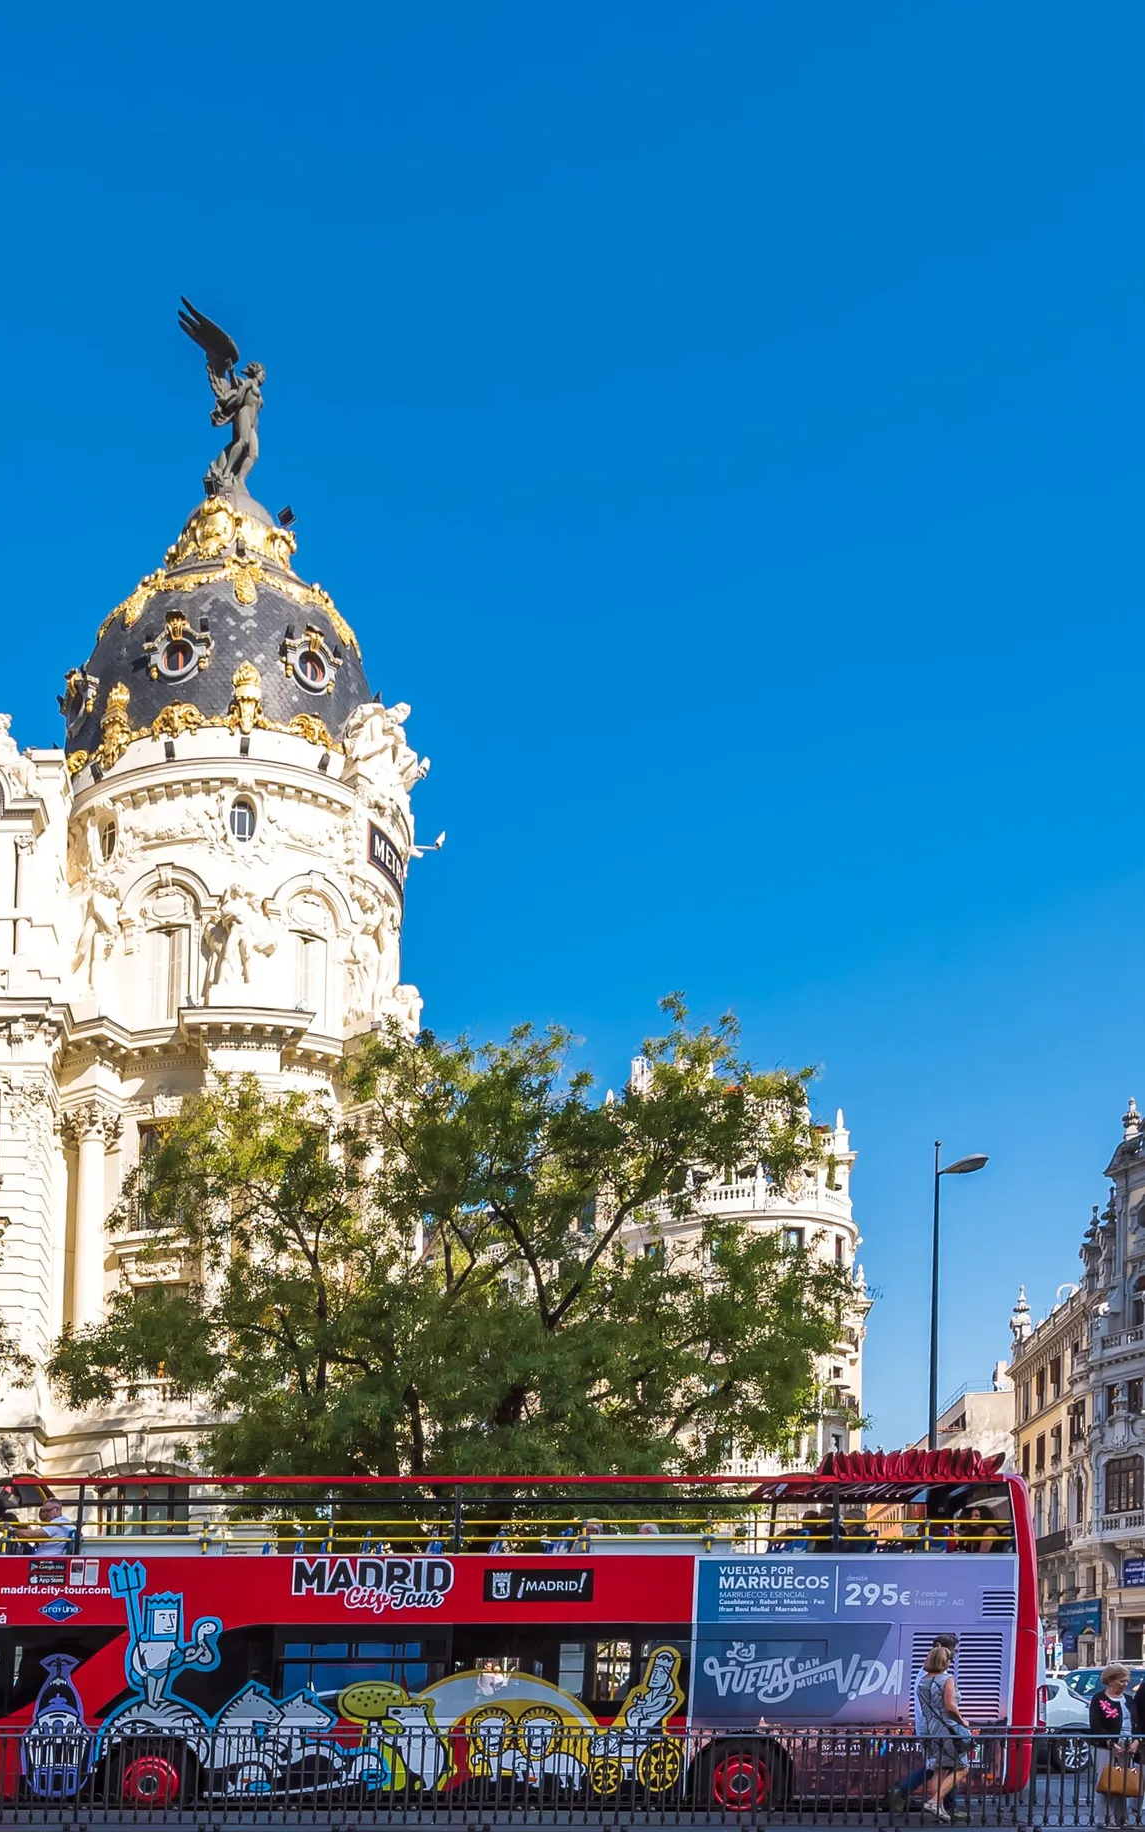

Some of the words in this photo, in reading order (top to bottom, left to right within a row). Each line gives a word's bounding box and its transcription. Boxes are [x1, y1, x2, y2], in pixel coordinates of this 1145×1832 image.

[292, 1558, 454, 1596] MADRID
[719, 1566, 767, 1575] VUELTAS
[771, 1566, 794, 1575] POR
[0, 1585, 111, 1596] madrid.city-tour.com
[517, 1572, 587, 1599] ¡MADRID!
[719, 1576, 830, 1589] MARRUECOS
[345, 1587, 390, 1613] City
[390, 1586, 444, 1609] Tour
[844, 1583, 911, 1606] 295€
[726, 1641, 755, 1662] Las
[797, 1657, 820, 1673] DAN
[703, 1655, 797, 1704] VUELTAS
[796, 1670, 837, 1689] MUCHA
